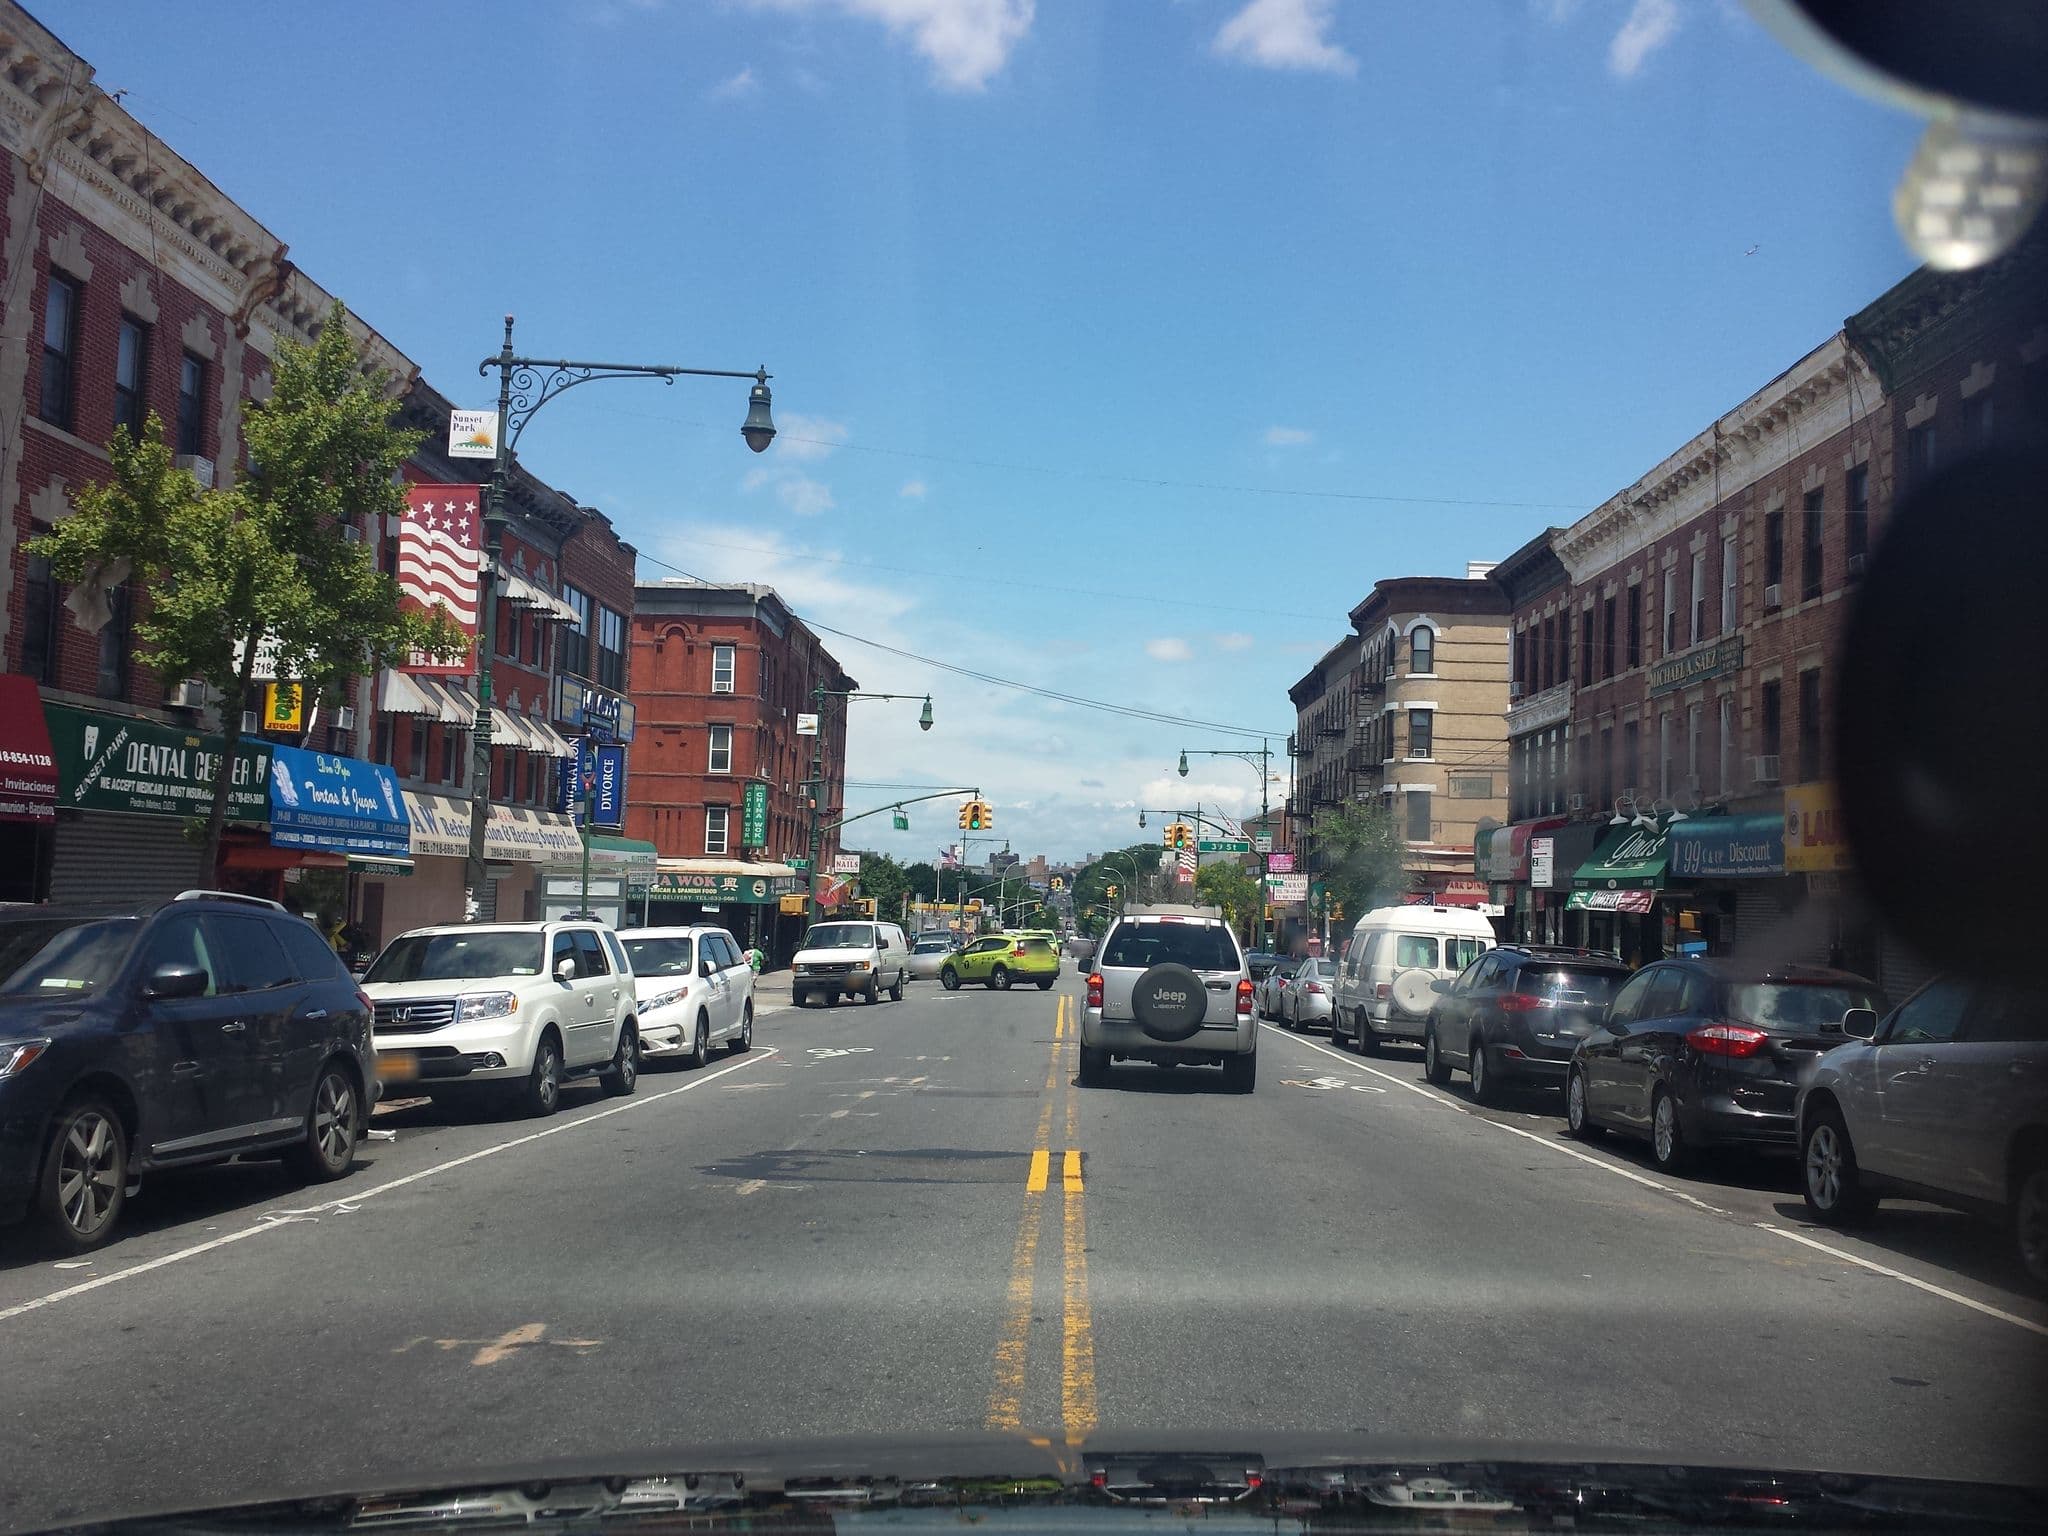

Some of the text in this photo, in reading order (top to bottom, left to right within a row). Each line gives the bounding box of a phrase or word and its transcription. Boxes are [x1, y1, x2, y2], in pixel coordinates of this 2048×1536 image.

[453, 413, 482, 424] Sunset
[453, 423, 475, 433] Park
[1649, 661, 1686, 689] MICHAEL
[267, 722, 299, 730] JUGOS
[74, 726, 129, 802] SUNSET PARK
[126, 741, 250, 786] DENTAL CEER
[5, 777, 56, 793] Invitaciones
[100, 776, 112, 790] WE
[111, 779, 137, 793] ACCEPT
[136, 781, 164, 797] MEDICAID
[169, 786, 187, 799] MOST
[565, 736, 580, 823] MMIGRATION
[601, 759, 615, 811] DIVORCE
[304, 781, 379, 815] Tortas & Jugos
[755, 791, 764, 818] CHINA
[439, 817, 503, 843] Refrition
[511, 824, 543, 848] Heating
[538, 829, 567, 849] Supply
[754, 821, 763, 839] WOK
[1729, 840, 1771, 862] Discount
[836, 861, 858, 869] NAILS
[677, 875, 716, 887] WOK
[1152, 988, 1187, 1003] Jeep
